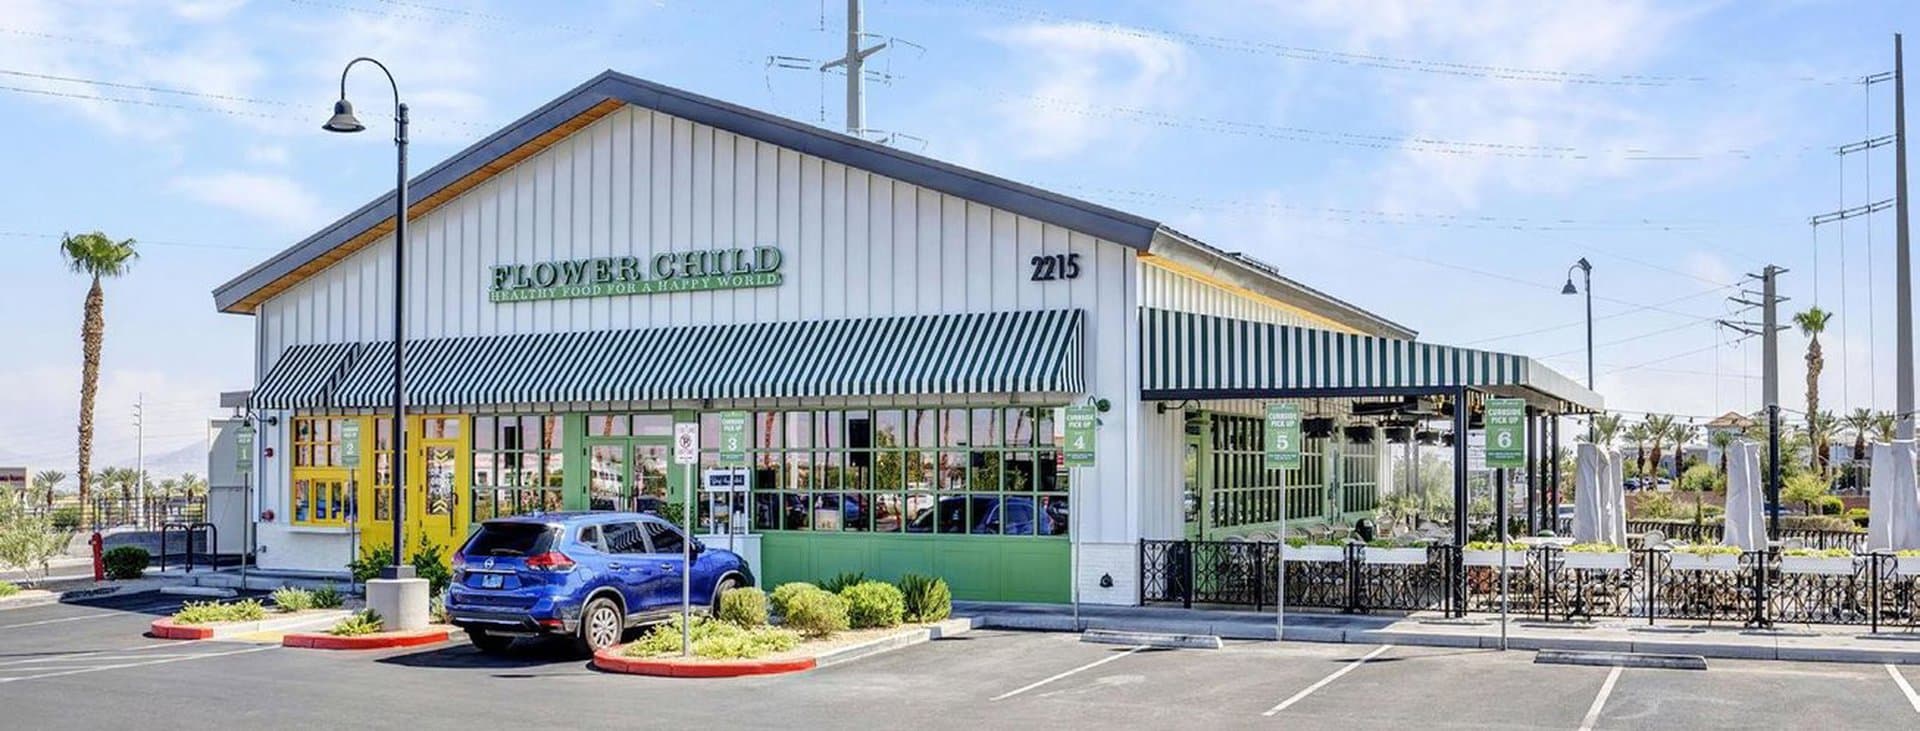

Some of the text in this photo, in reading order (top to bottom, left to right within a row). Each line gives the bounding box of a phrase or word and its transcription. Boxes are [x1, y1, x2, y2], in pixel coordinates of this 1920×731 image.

[489, 246, 782, 290] FLOWER CHILD
[1031, 253, 1080, 281] 2215
[491, 287, 559, 301] HEALTHY
[562, 284, 601, 297] FOOD
[607, 282, 636, 293] FOR
[642, 283, 651, 292] A
[658, 278, 711, 291] HAPPY
[1268, 412, 1298, 420] CURBSIDE
[1488, 408, 1521, 416] CURBSIDE
[1491, 416, 1507, 424] PICK
[728, 438, 738, 451] 3
[1073, 435, 1086, 450] 4
[1276, 435, 1289, 450] 5
[1498, 431, 1512, 448] 6
[346, 442, 354, 456] 2
